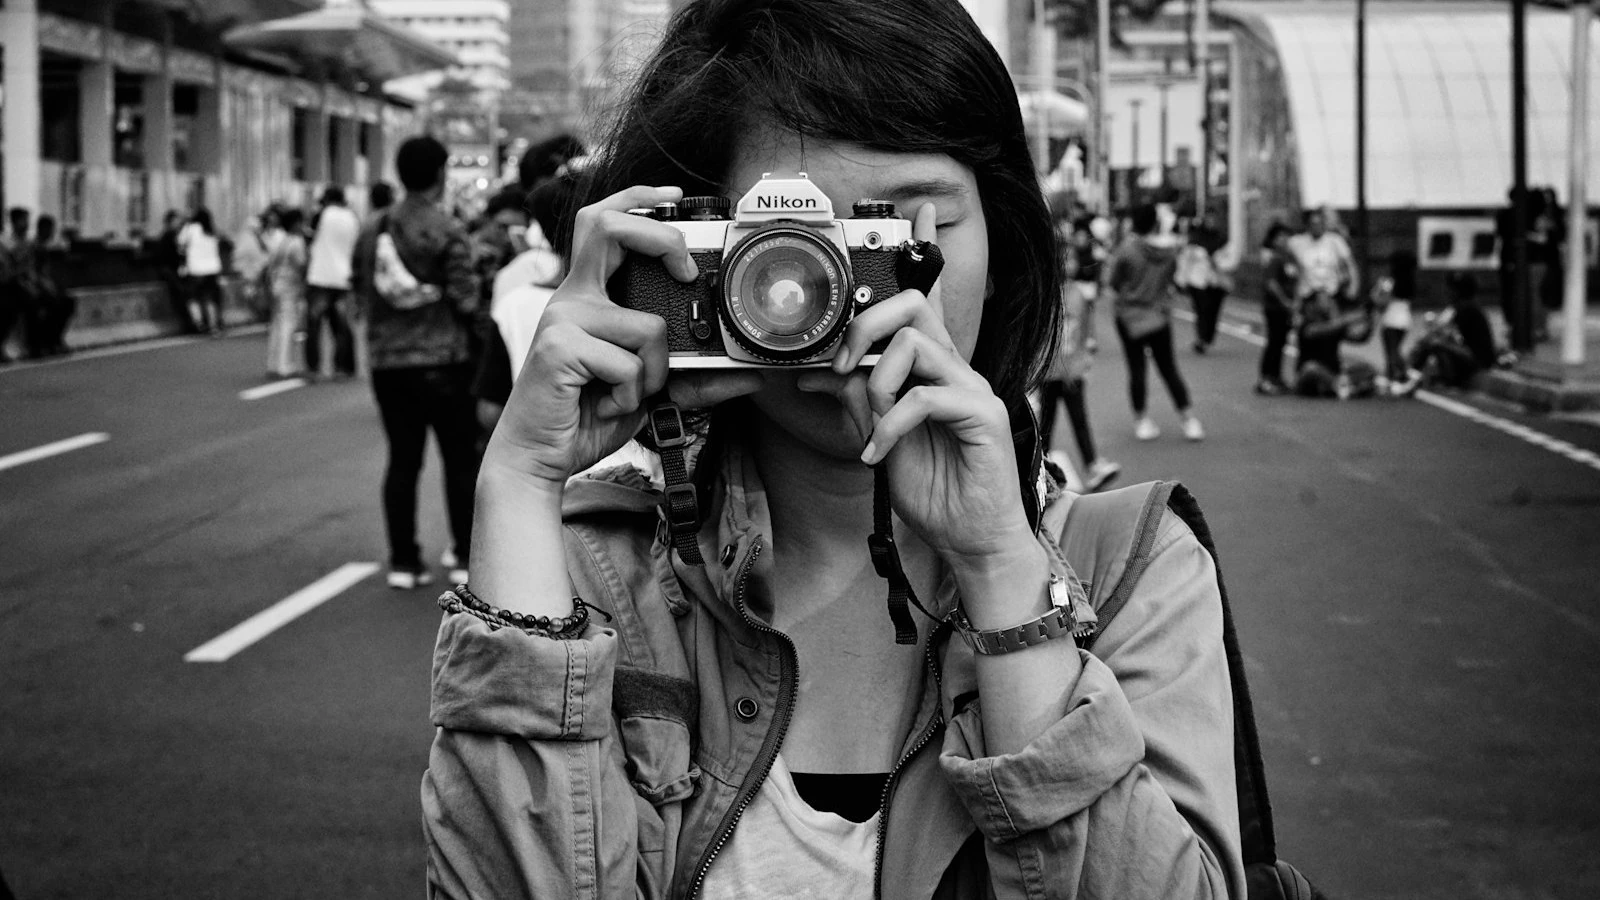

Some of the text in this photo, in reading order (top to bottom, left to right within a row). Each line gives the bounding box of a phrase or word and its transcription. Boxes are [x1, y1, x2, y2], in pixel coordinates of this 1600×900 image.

[757, 195, 817, 208] Nikon
[817, 252, 836, 279] Nikon
[830, 283, 839, 306] LENS
[743, 319, 762, 339] 50mm
[811, 310, 834, 336] SERIES
